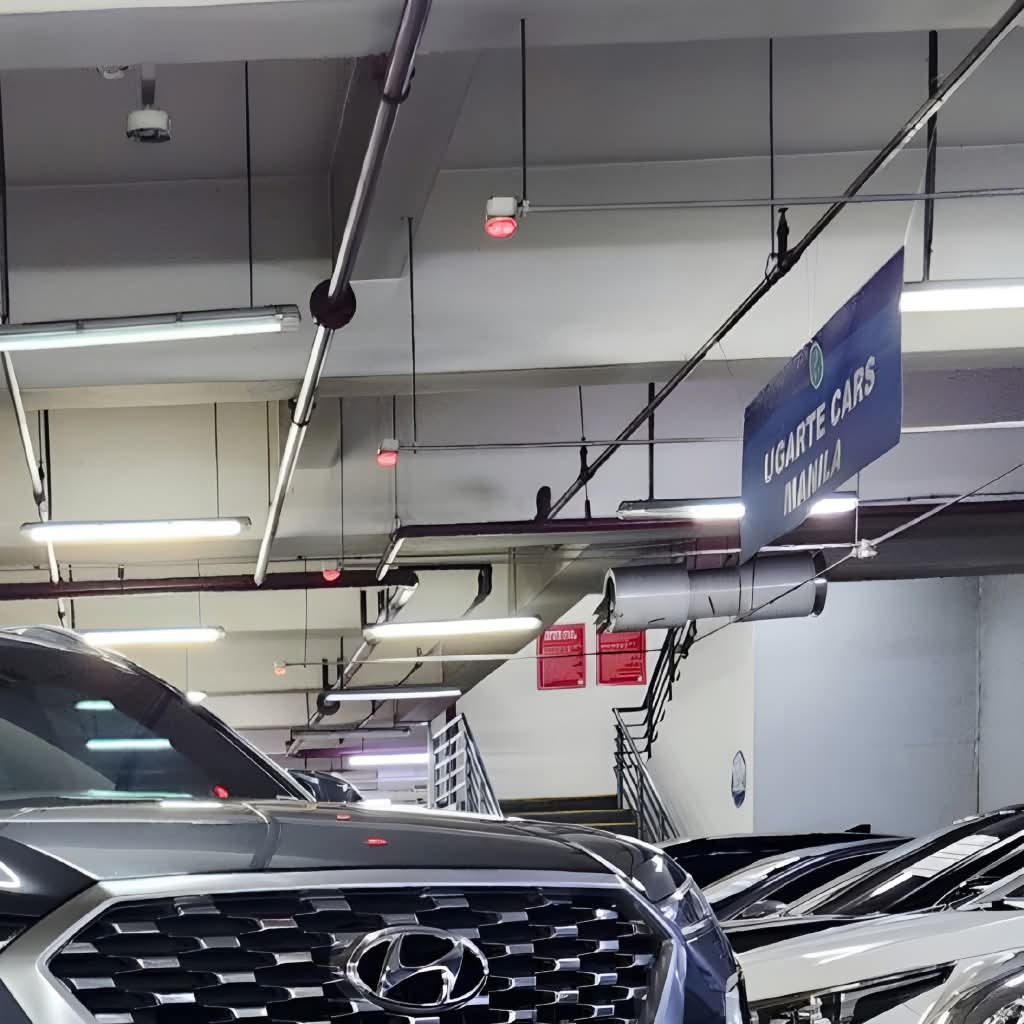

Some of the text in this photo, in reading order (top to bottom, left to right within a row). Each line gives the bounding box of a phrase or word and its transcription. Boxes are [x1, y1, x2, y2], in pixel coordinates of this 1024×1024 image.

[764, 355, 876, 484] UGARTE CARS
[783, 438, 841, 517] MANILA
